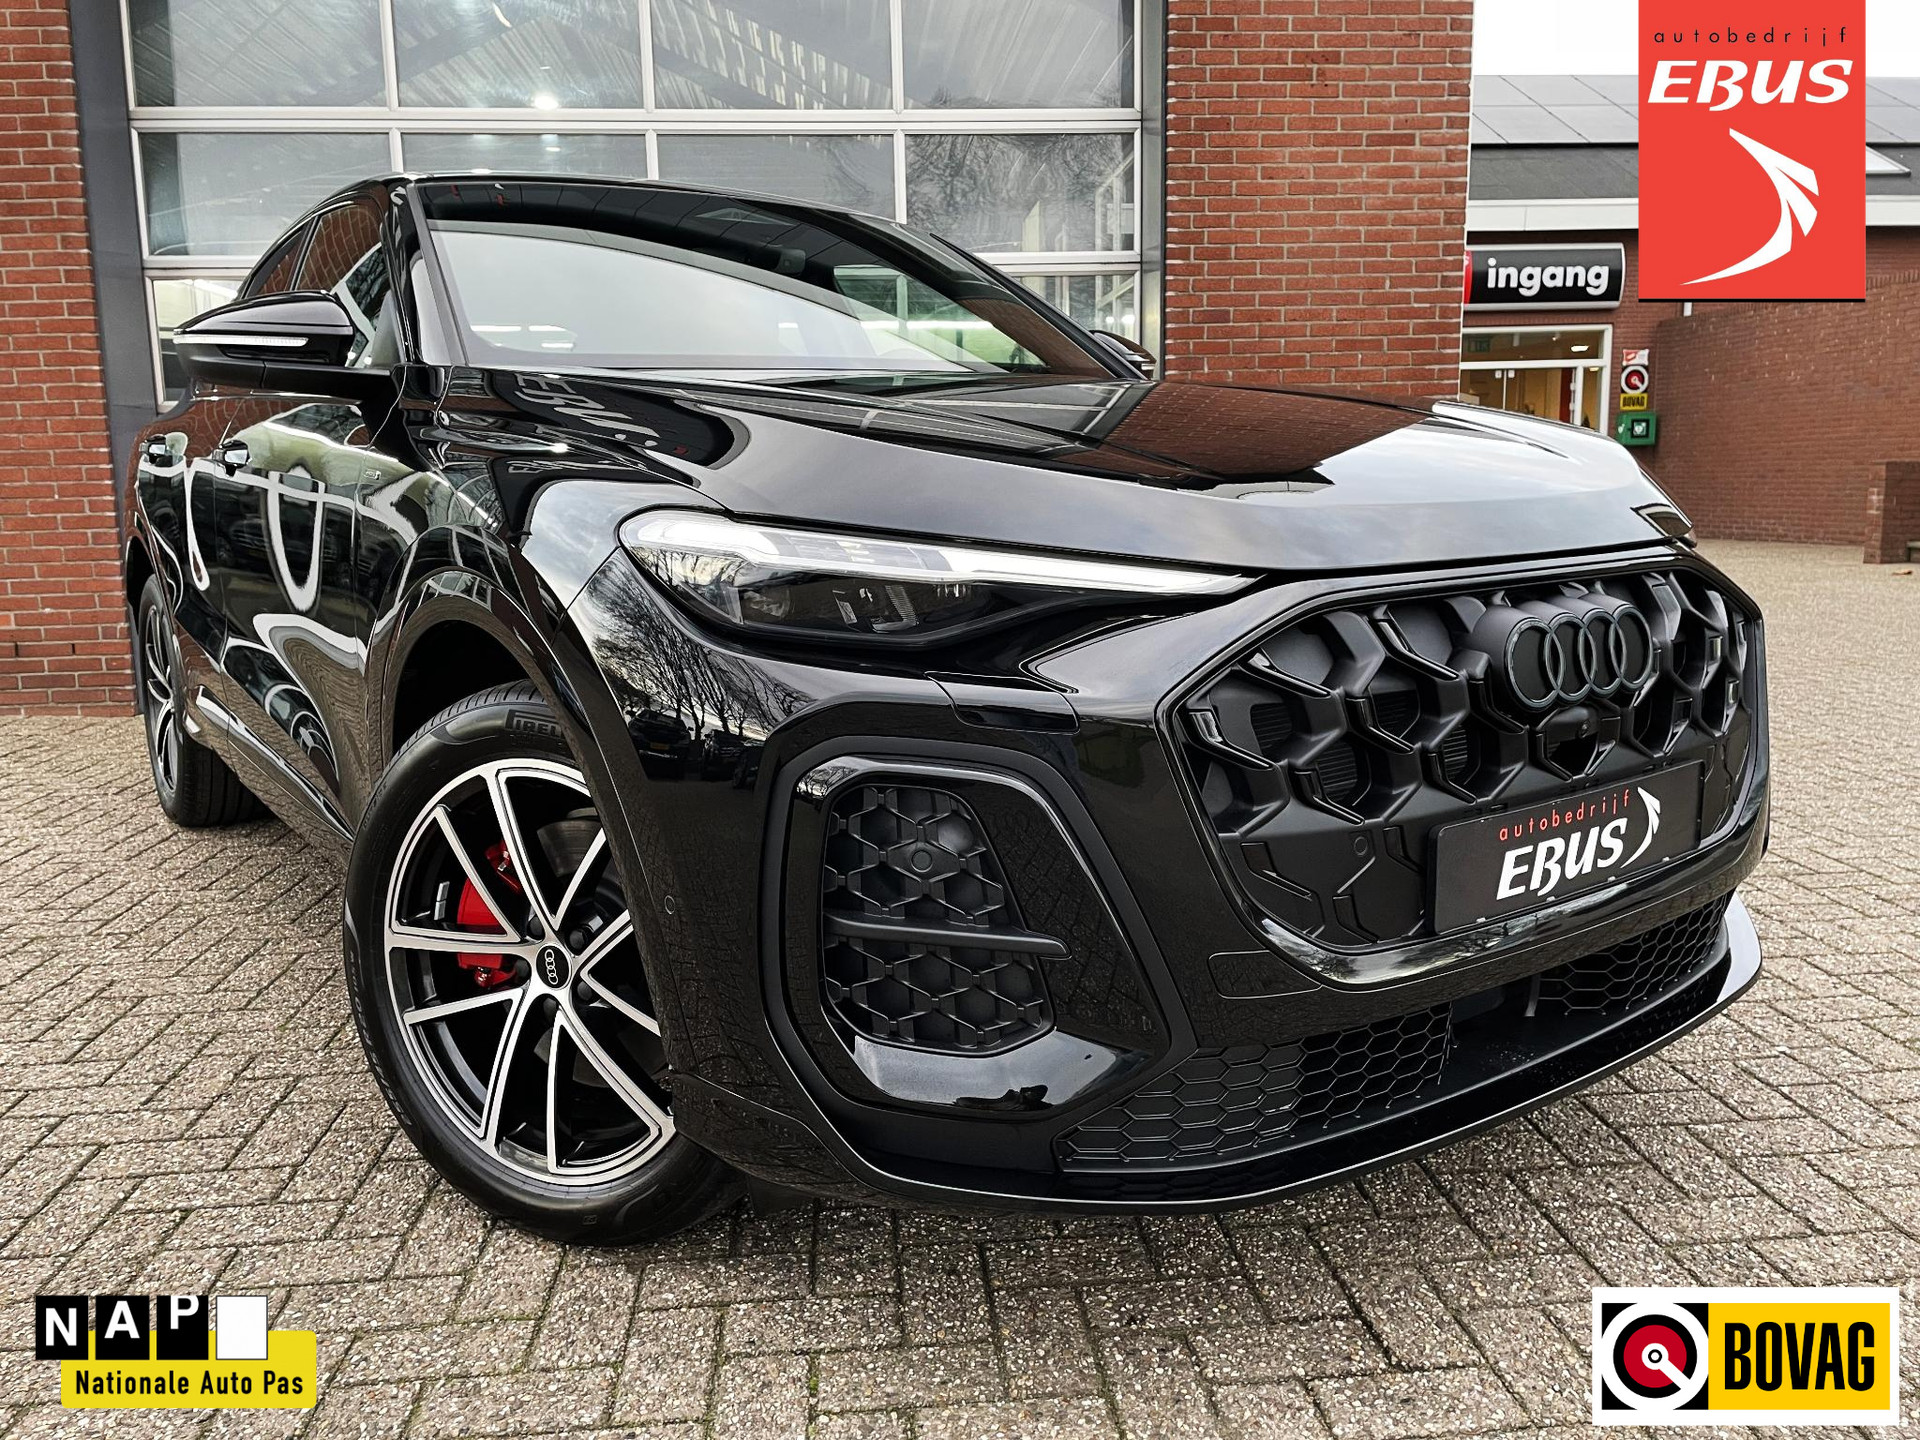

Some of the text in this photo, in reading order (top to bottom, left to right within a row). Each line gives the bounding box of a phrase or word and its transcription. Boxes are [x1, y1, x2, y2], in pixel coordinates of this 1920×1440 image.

[1487, 257, 1610, 296] ingang
[505, 709, 562, 738] PIREL
[1499, 788, 1630, 841] autobedrijf
[1496, 817, 1628, 901] EBUS
